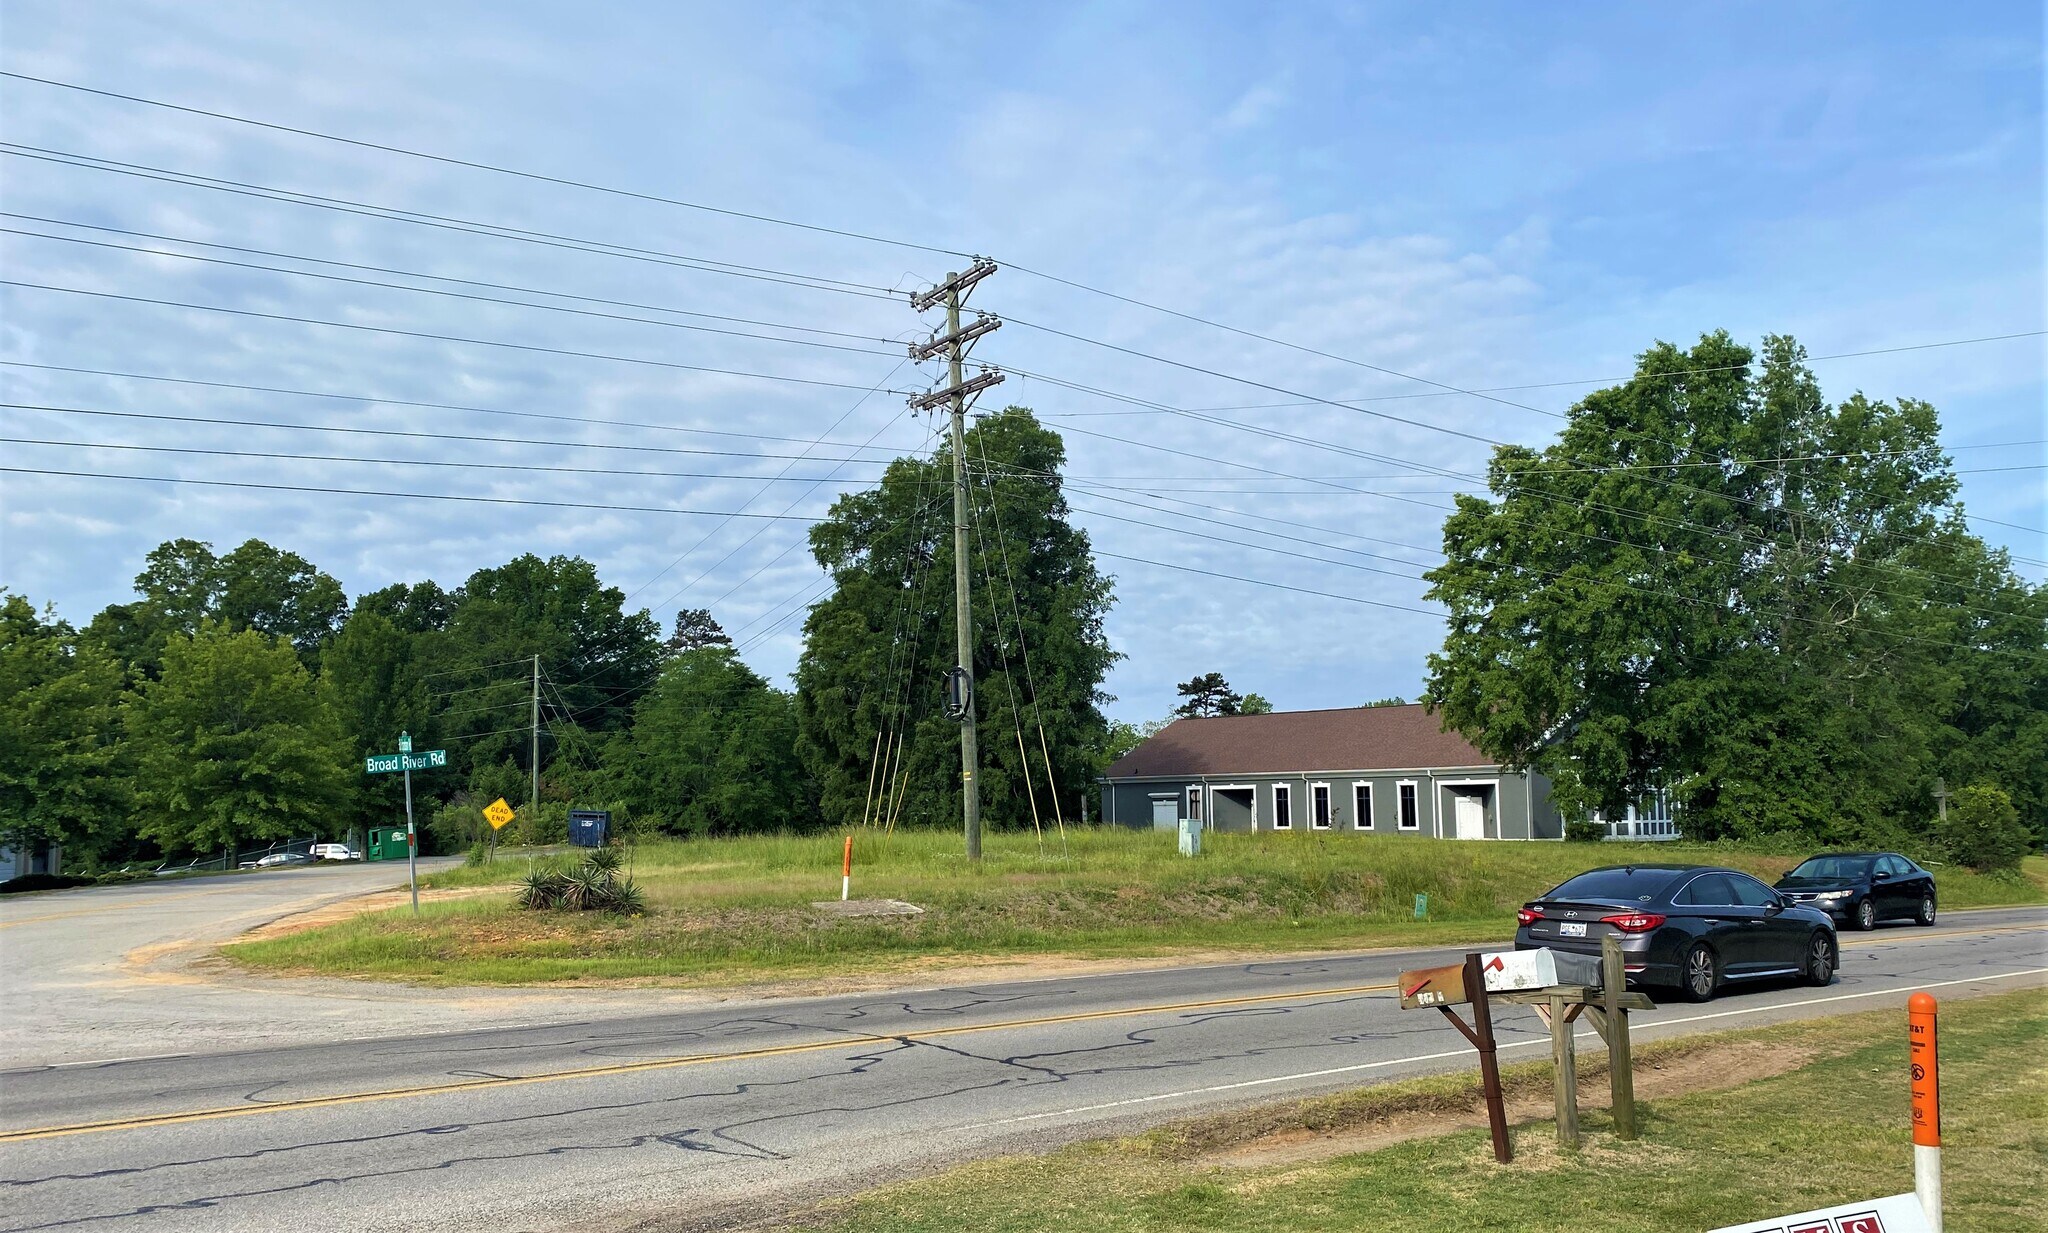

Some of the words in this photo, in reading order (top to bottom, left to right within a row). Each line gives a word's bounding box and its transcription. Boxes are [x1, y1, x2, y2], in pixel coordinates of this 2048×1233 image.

[367, 756, 398, 772] Broad
[402, 755, 427, 769] River
[430, 752, 445, 766] Rd
[490, 806, 509, 815] DEAD
[491, 814, 506, 822] END
